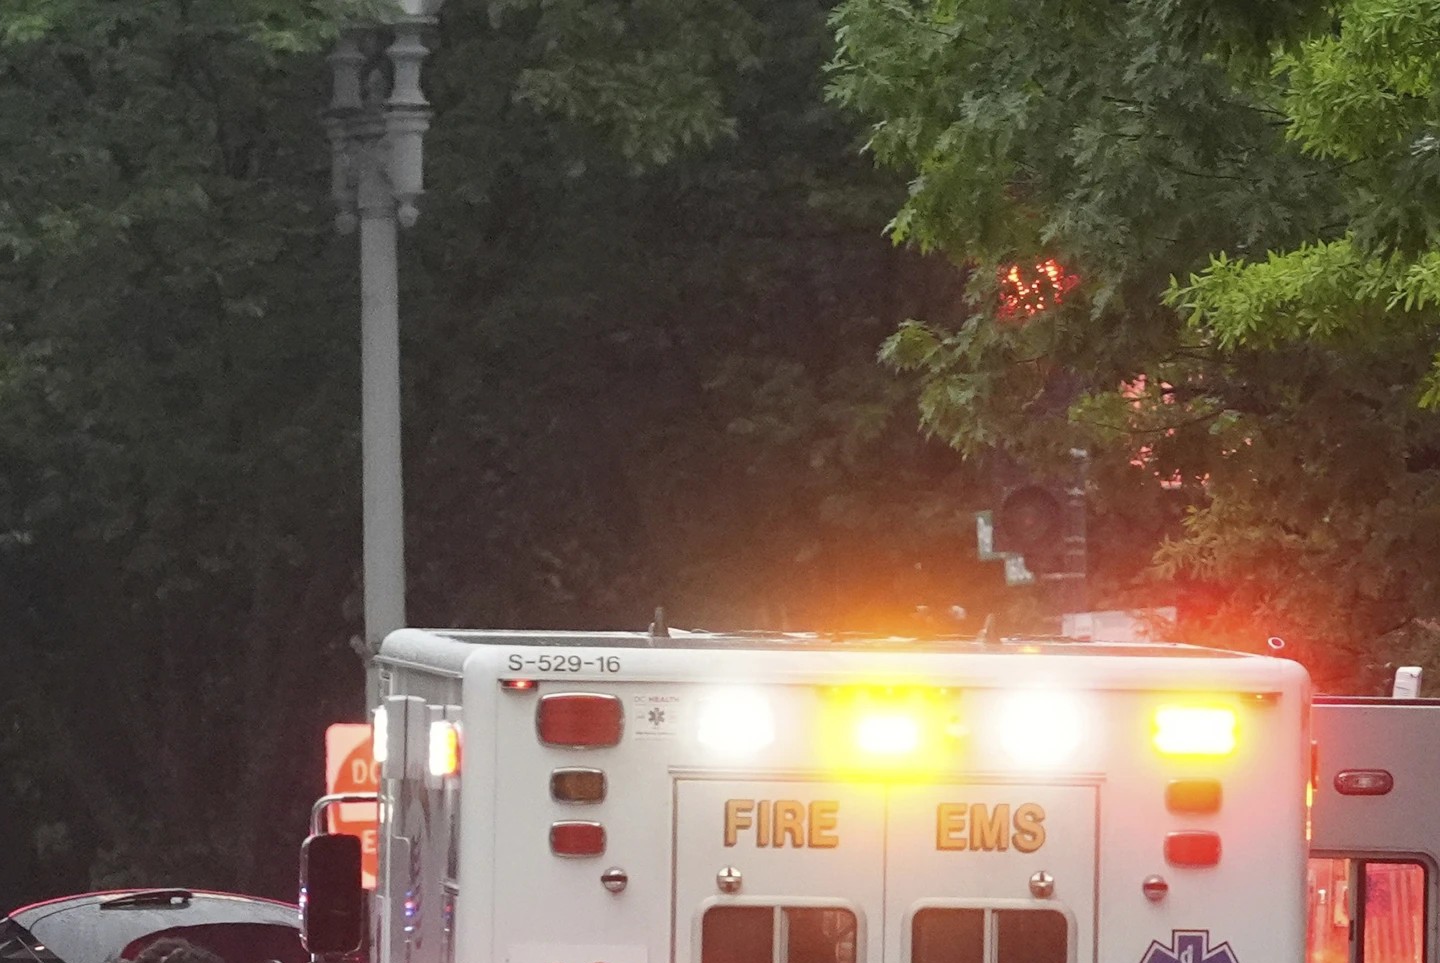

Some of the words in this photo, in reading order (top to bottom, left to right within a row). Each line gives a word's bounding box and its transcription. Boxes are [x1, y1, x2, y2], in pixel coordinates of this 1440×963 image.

[508, 654, 621, 673] S-529-16
[724, 799, 840, 849] FIRE
[936, 802, 1047, 853] EMS
